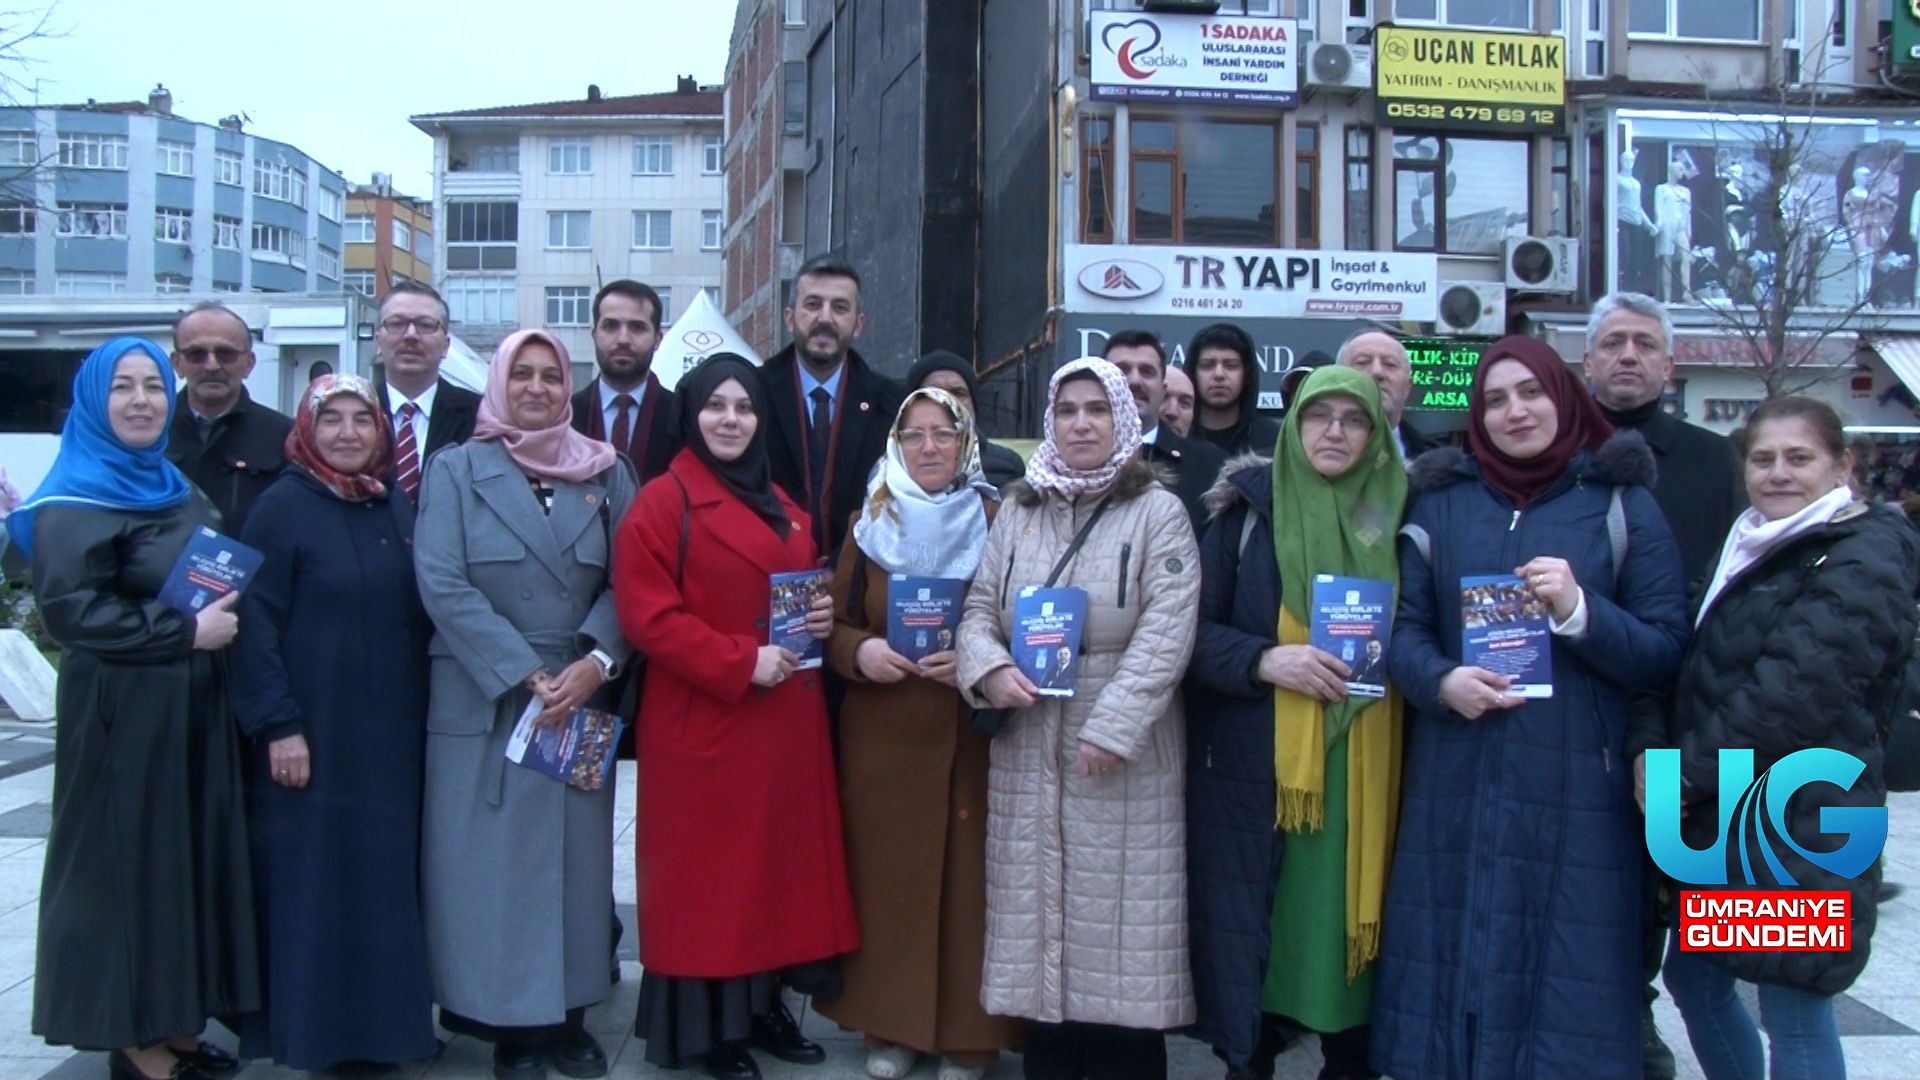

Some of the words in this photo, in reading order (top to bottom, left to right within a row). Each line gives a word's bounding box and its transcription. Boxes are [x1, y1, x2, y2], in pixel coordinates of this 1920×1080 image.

[1200, 24, 1208, 38] 1
[1212, 24, 1287, 42] SADAKA
[1485, 41, 1559, 69] EMLAK
[1384, 73, 1443, 88] YATIRIM
[1457, 75, 1557, 93] DANIŞMANLIK
[1386, 103, 1446, 119] 0532
[1449, 105, 1493, 122] 479
[1530, 110, 1555, 124] 12
[1174, 253, 1225, 289] TR
[1234, 255, 1321, 290] YAPI
[1331, 257, 1376, 275] İnşaat
[1380, 261, 1390, 274] &
[1331, 278, 1426, 295] Gayrimenkul
[1171, 298, 1195, 308] 0216
[1217, 298, 1229, 309] 24
[1231, 298, 1243, 309] 20
[1421, 390, 1469, 407] ARSA
